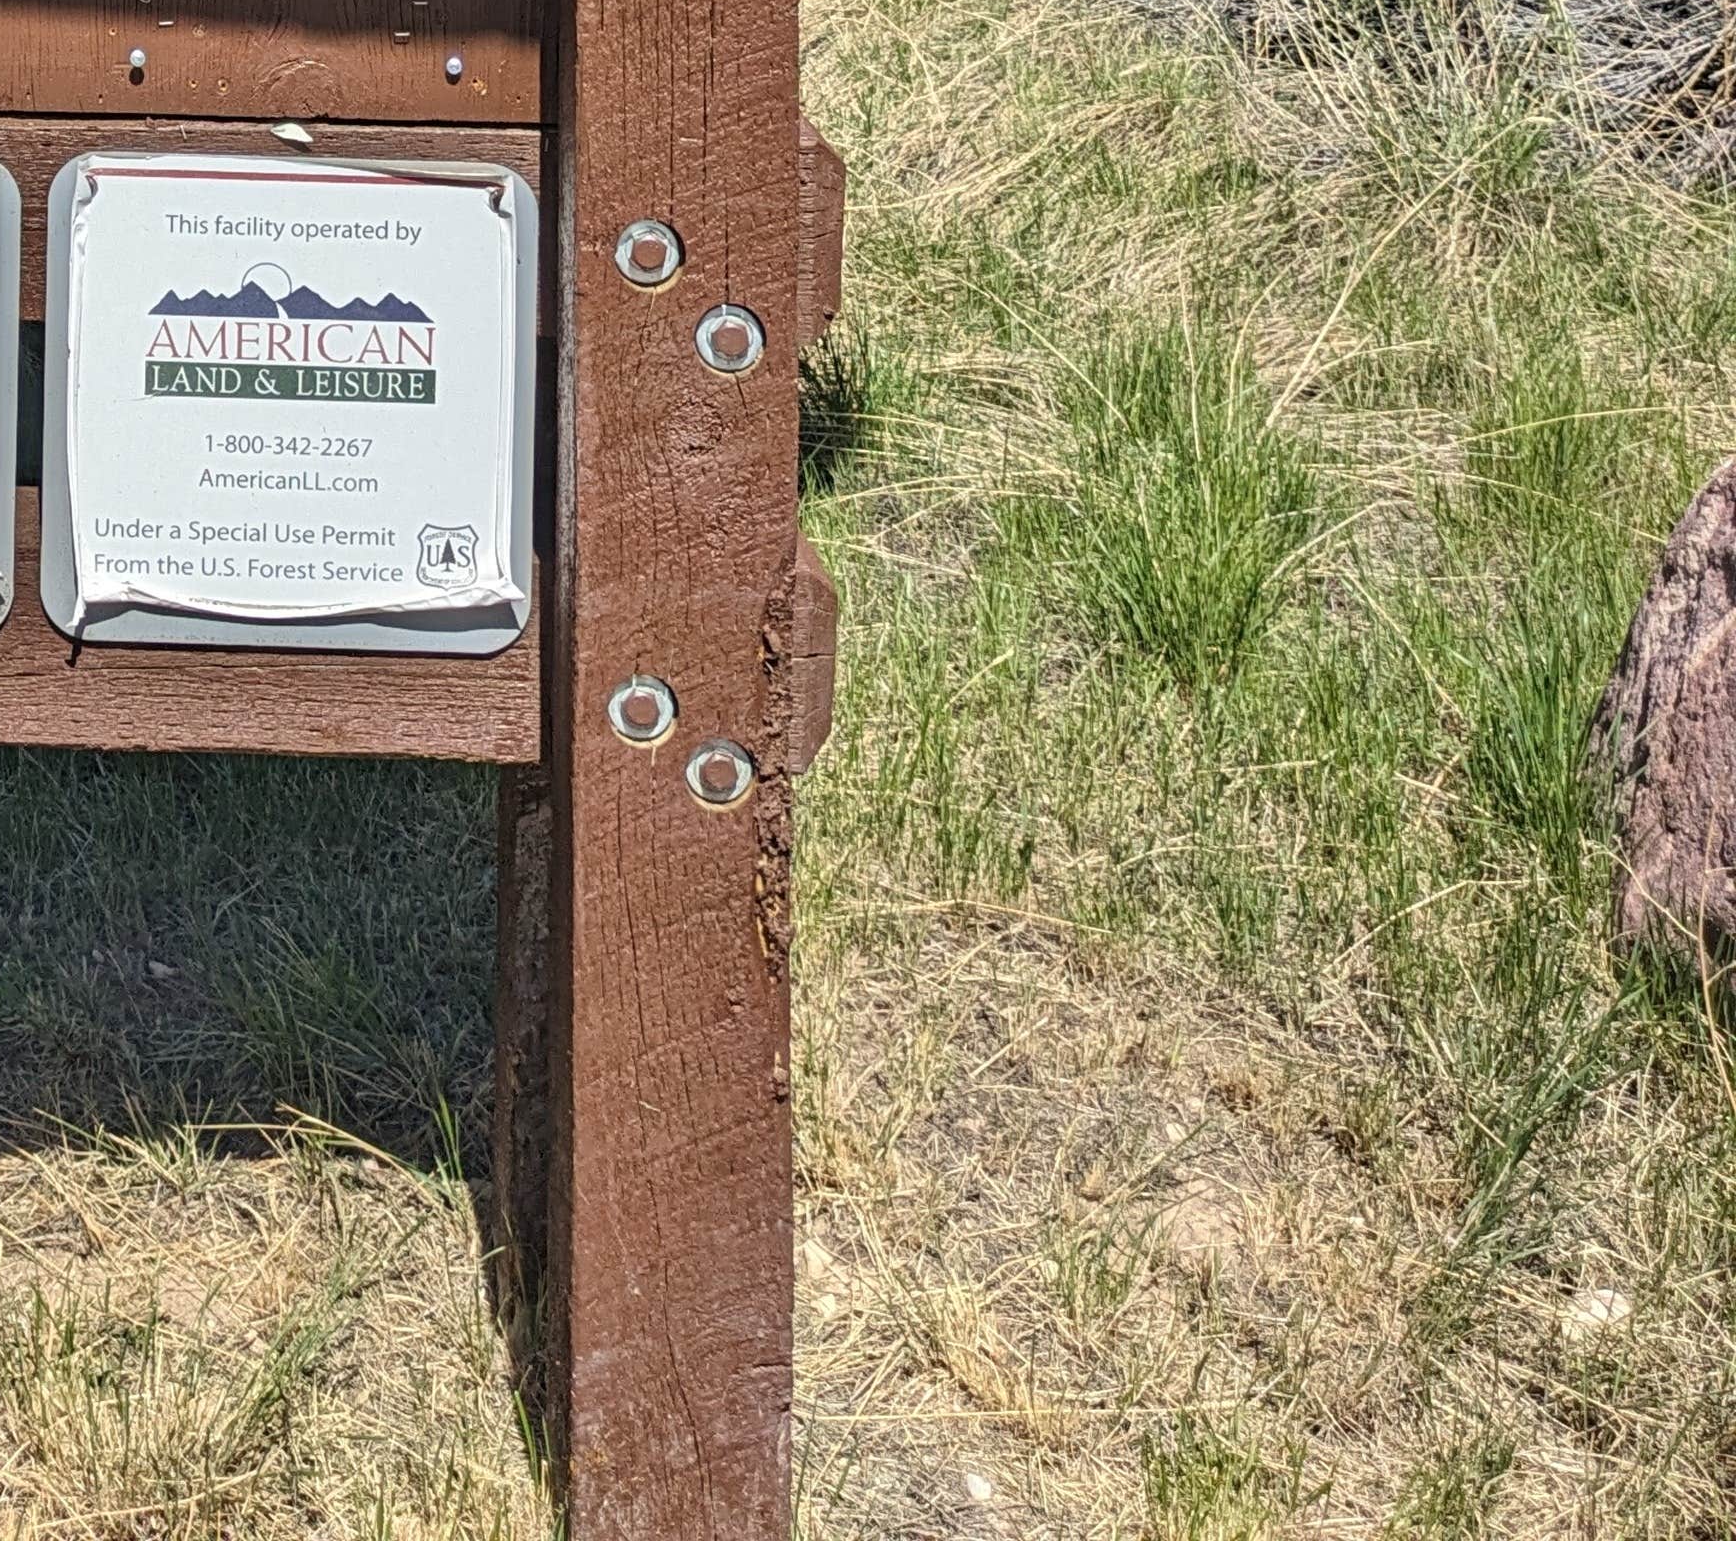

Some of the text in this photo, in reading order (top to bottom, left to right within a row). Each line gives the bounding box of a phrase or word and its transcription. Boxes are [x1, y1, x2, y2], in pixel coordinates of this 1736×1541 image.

[166, 214, 421, 245] This facility operated by
[145, 319, 436, 366] AMERICAN
[152, 365, 426, 400] LAND & LEISURE
[204, 434, 373, 458] 1-800-342-2267
[199, 468, 379, 493] AmericanLL.com
[94, 518, 395, 547] Under a Special Use Permit
[94, 554, 150, 574] From
[156, 555, 193, 576] the
[201, 558, 241, 577] U.S.
[248, 558, 315, 579] Forest
[322, 561, 403, 582] Service
